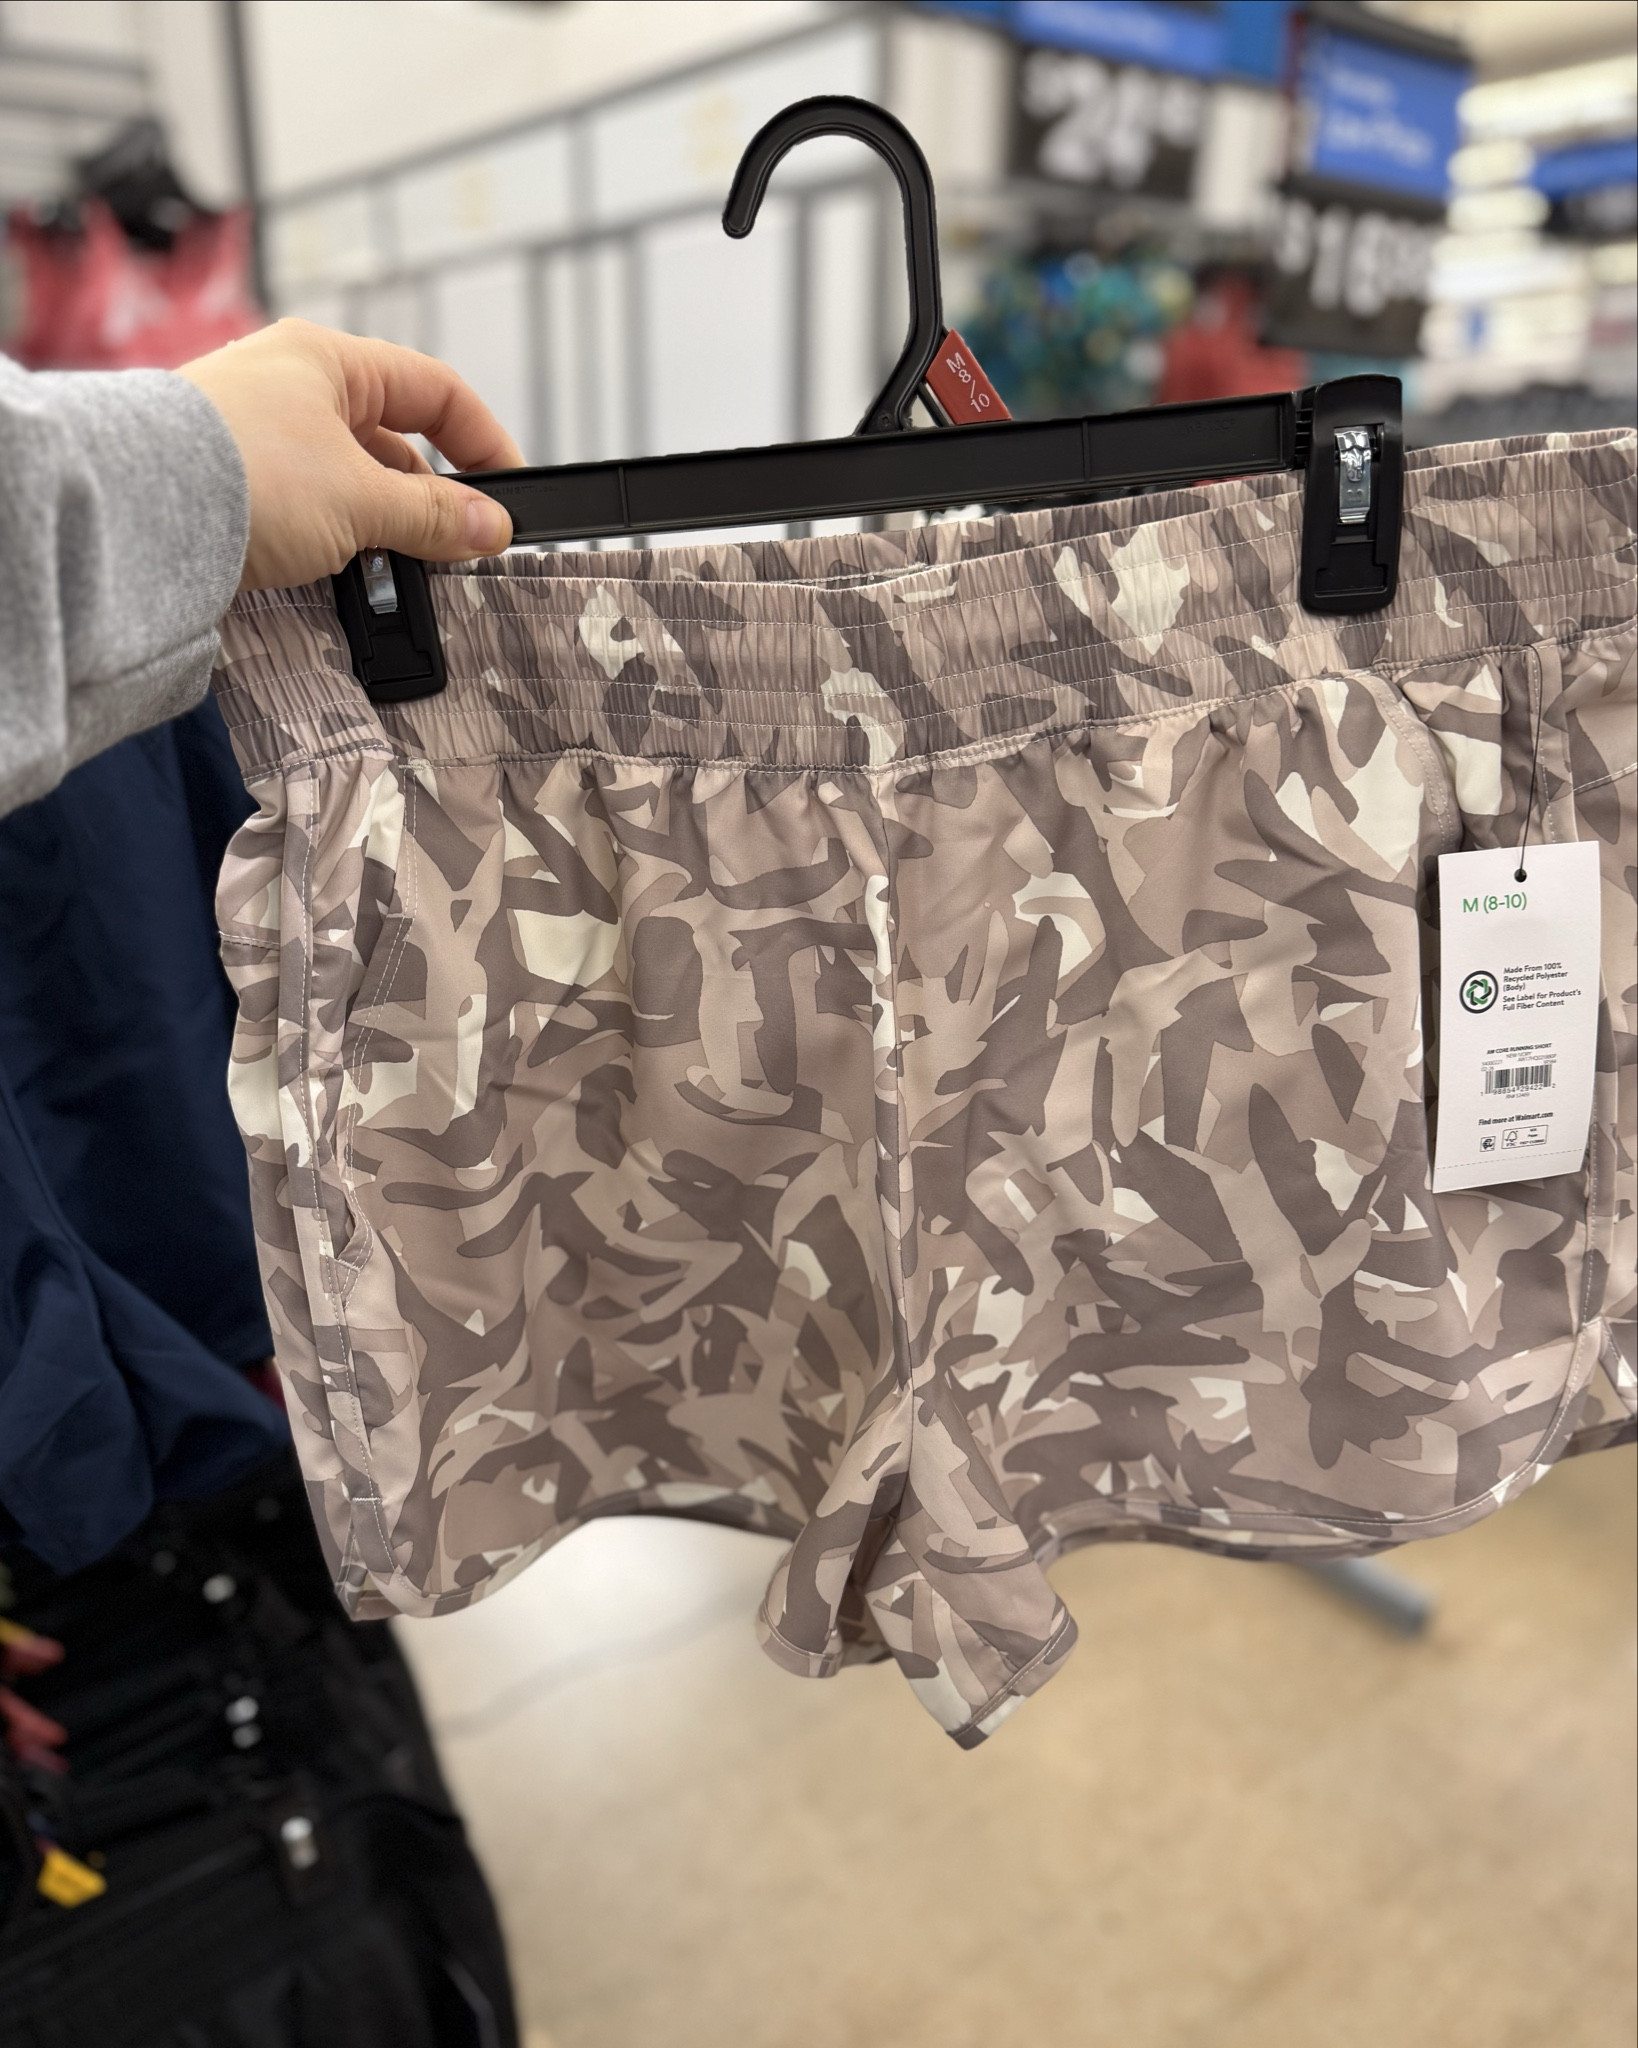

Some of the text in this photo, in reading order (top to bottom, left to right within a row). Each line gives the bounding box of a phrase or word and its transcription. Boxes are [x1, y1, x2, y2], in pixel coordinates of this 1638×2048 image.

[946, 352, 966, 373] M
[1463, 892, 1527, 914] M (8-10)
[1504, 962, 1562, 974] Made From 100%
[1503, 971, 1568, 983] Recycled Polyester
[1503, 983, 1526, 992] (Body)
[1503, 995, 1515, 1003] See
[1517, 993, 1535, 1002] Label
[1549, 989, 1581, 998] Product's
[1503, 1000, 1564, 1011] Full Fiber Content
[1515, 1112, 1554, 1121] Walmart.com
